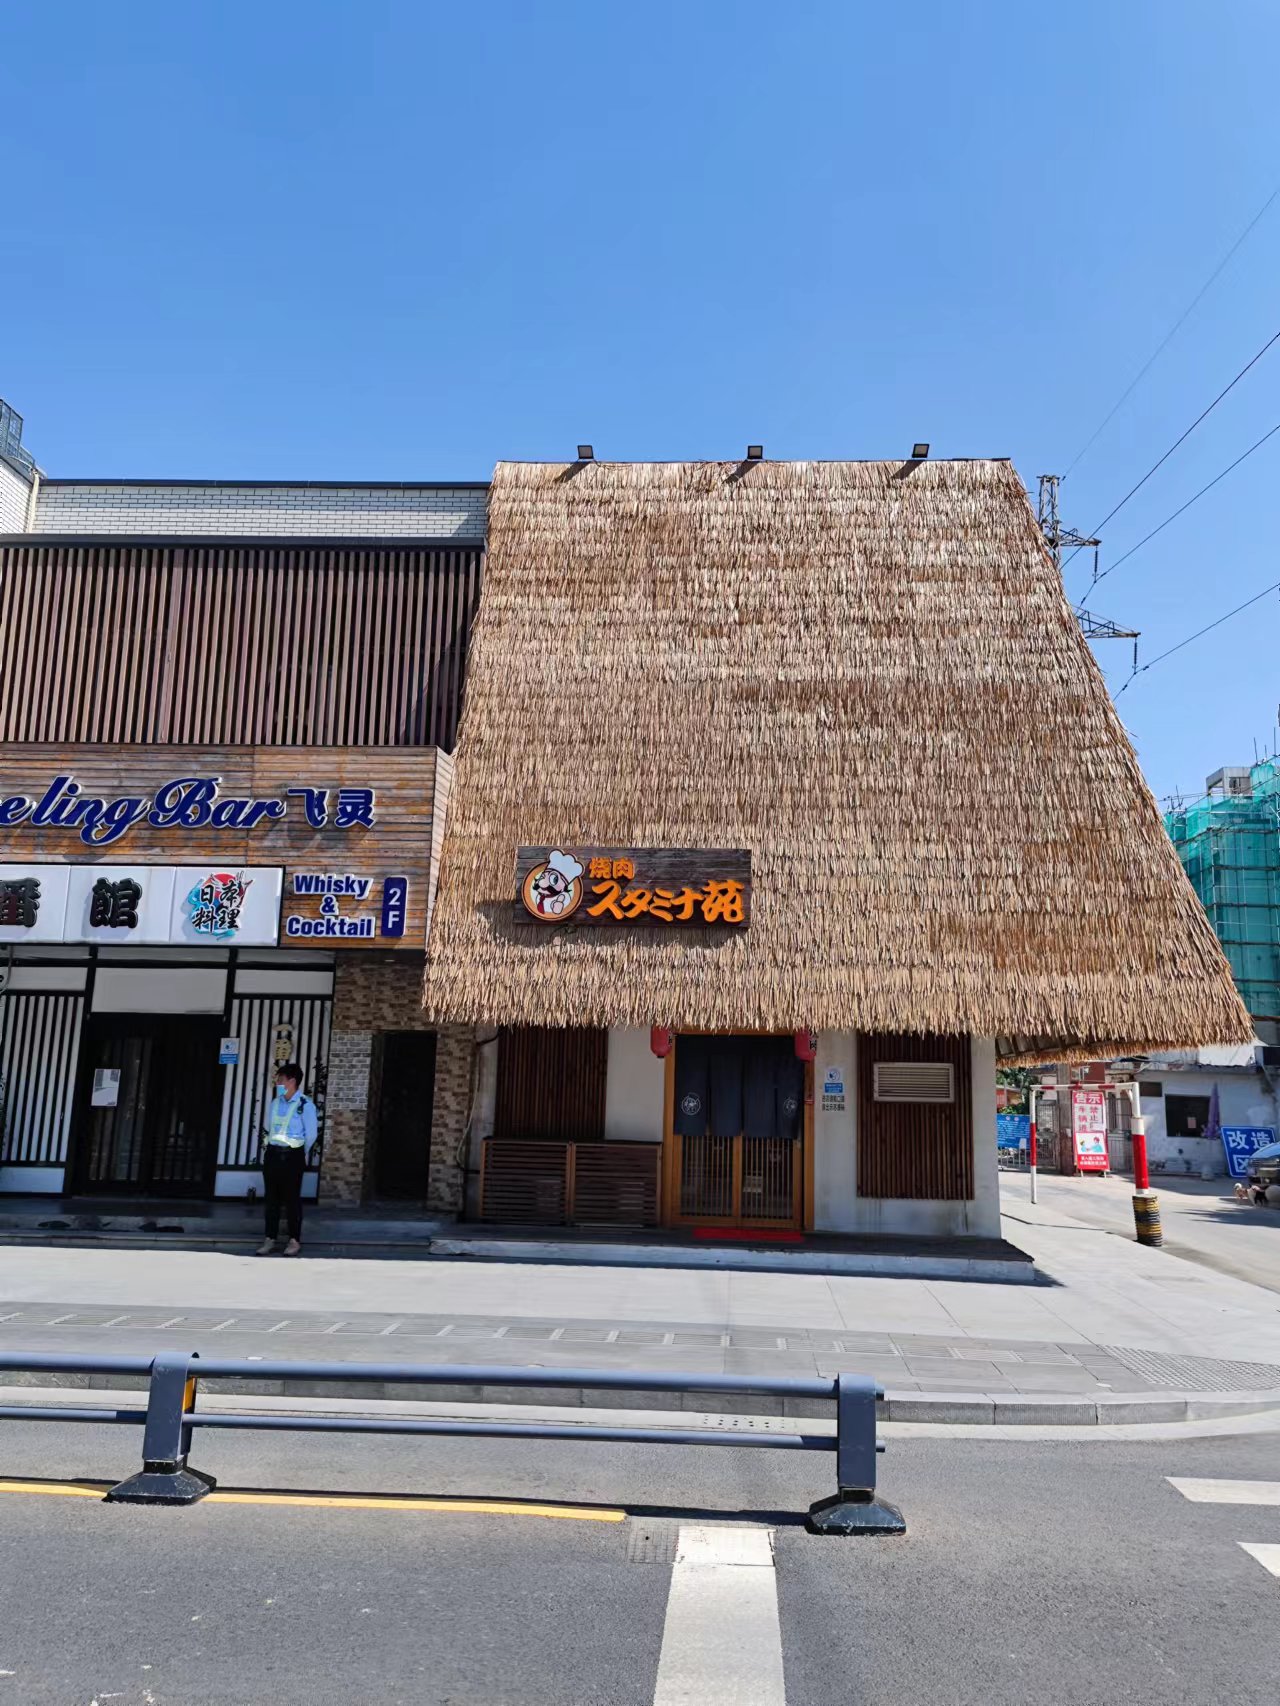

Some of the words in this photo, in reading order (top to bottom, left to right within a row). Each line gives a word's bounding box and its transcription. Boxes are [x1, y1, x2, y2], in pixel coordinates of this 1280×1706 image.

[148, 777, 287, 829] Bar
[287, 788, 376, 829] 飞灵
[199, 880, 240, 908] 日本
[293, 874, 373, 900] Whisky
[320, 894, 338, 915] &
[191, 905, 241, 933] 料理
[287, 915, 375, 938] Cocktail
[1226, 1130, 1271, 1150] 改造
